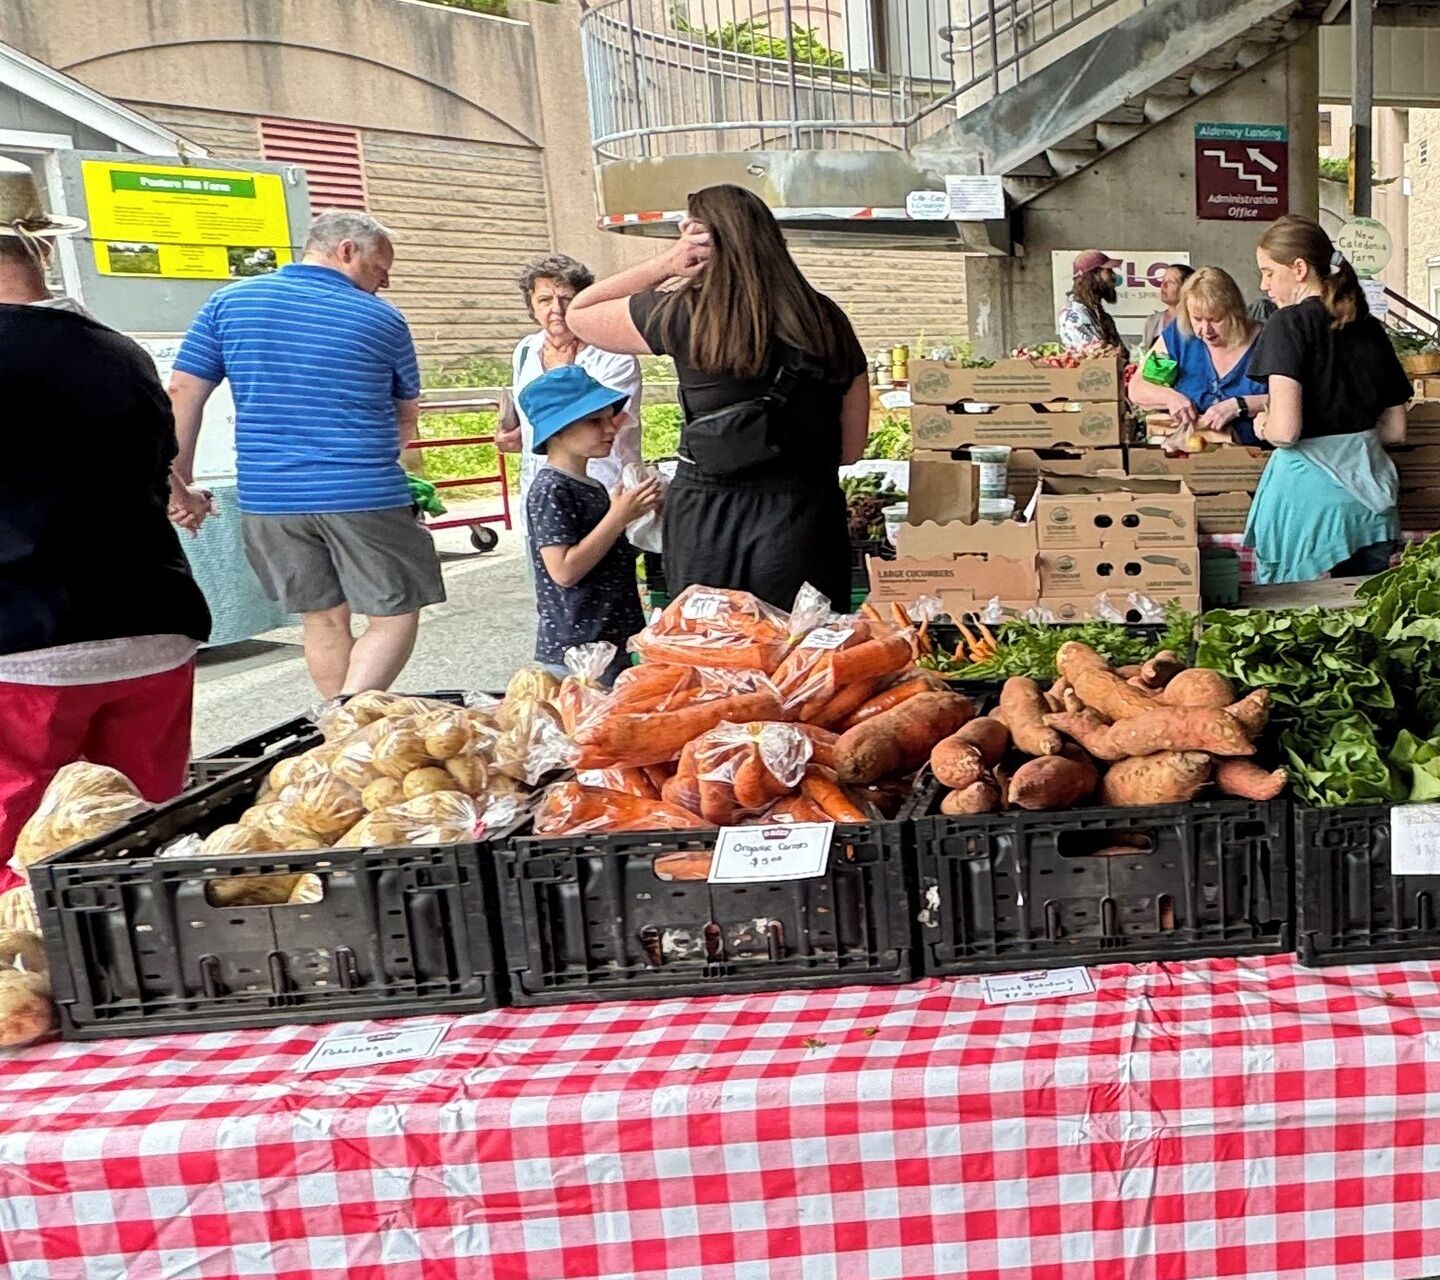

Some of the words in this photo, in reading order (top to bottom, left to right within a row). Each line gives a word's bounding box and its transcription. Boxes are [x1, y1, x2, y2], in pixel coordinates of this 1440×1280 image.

[1200, 126, 1243, 138] Alderney
[1244, 128, 1281, 140] Landing
[203, 180, 231, 192] Farm
[1207, 192, 1278, 205] Administration
[1228, 206, 1258, 218] Office
[1355, 230, 1375, 240] New
[1338, 236, 1387, 251] Caledonia
[1351, 250, 1376, 265] Farm
[879, 570, 904, 578] LARGE
[733, 843, 773, 857] Organic
[778, 842, 808, 851] Carrots
[322, 1045, 379, 1056] Potatoes
